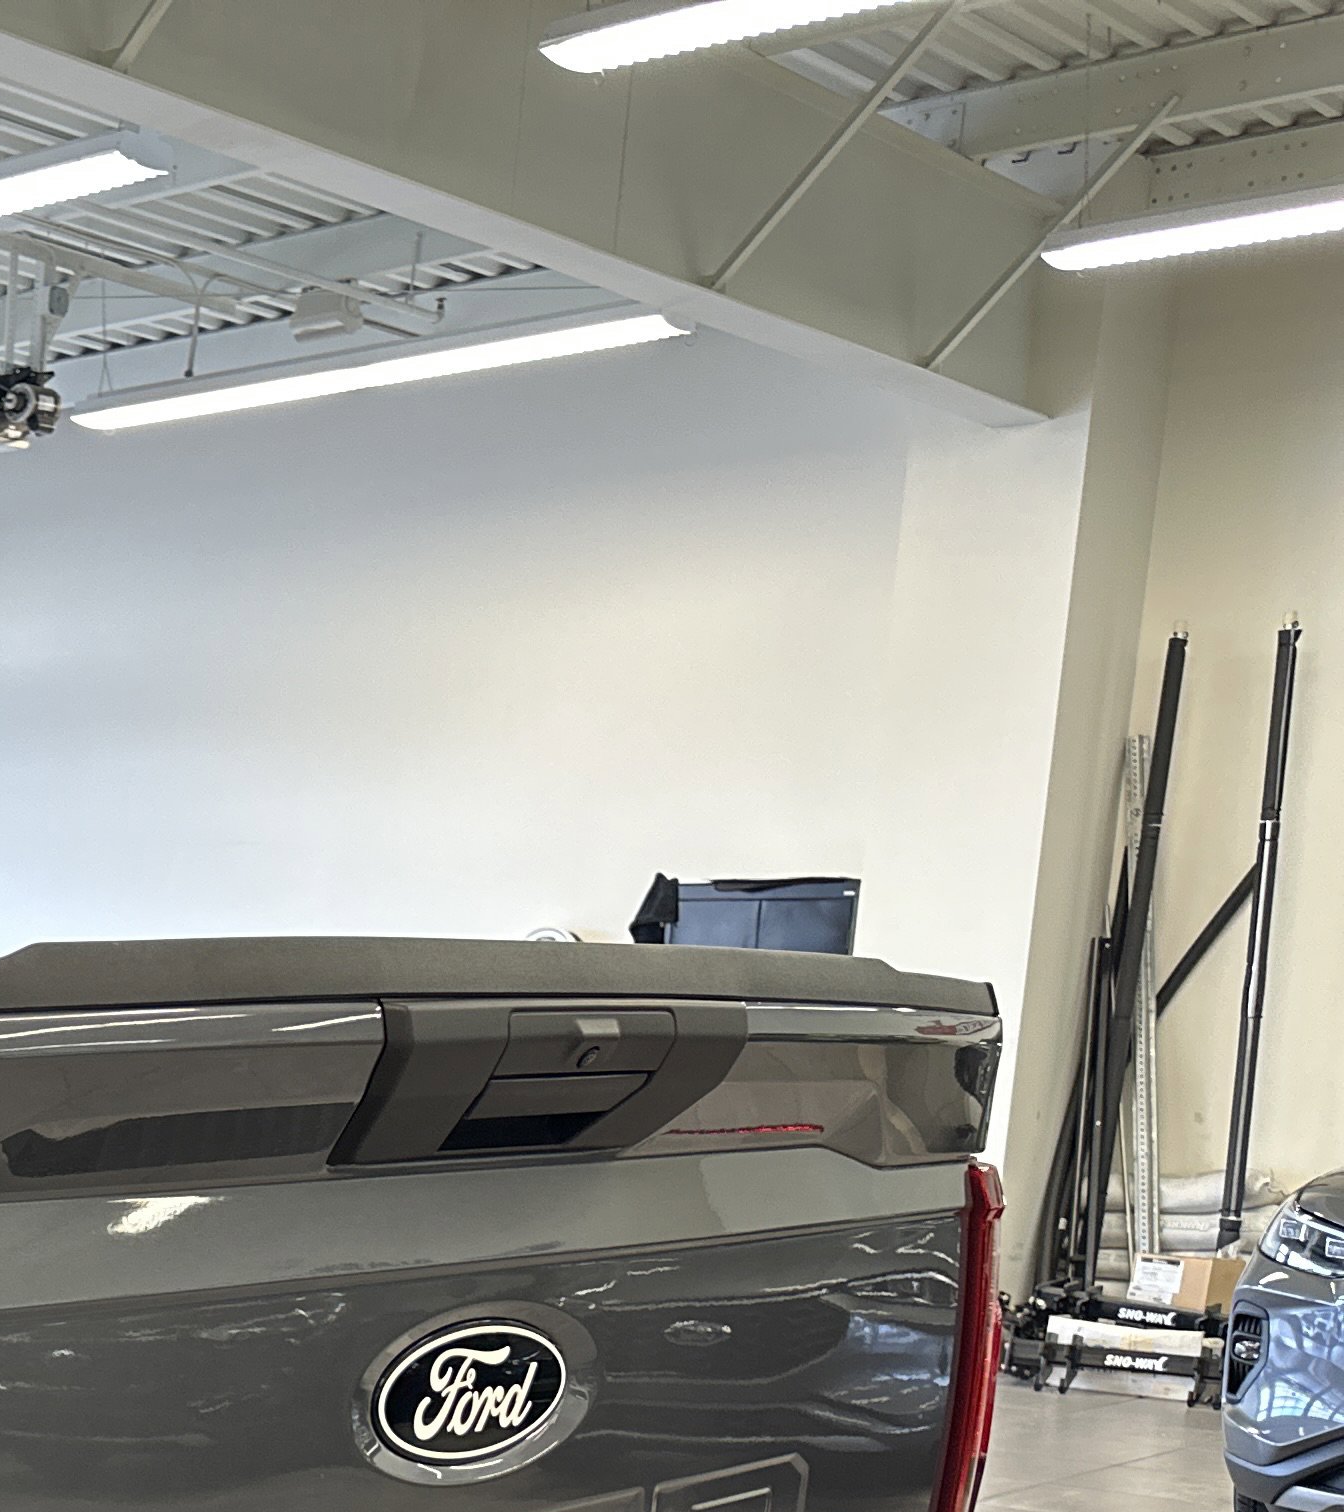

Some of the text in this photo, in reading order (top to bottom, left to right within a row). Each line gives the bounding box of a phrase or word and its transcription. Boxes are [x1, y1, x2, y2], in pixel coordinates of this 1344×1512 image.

[1117, 1307, 1176, 1326] SNO-WAY
[1103, 1353, 1168, 1372] SNO-WAY
[413, 1345, 539, 1441] Ford
